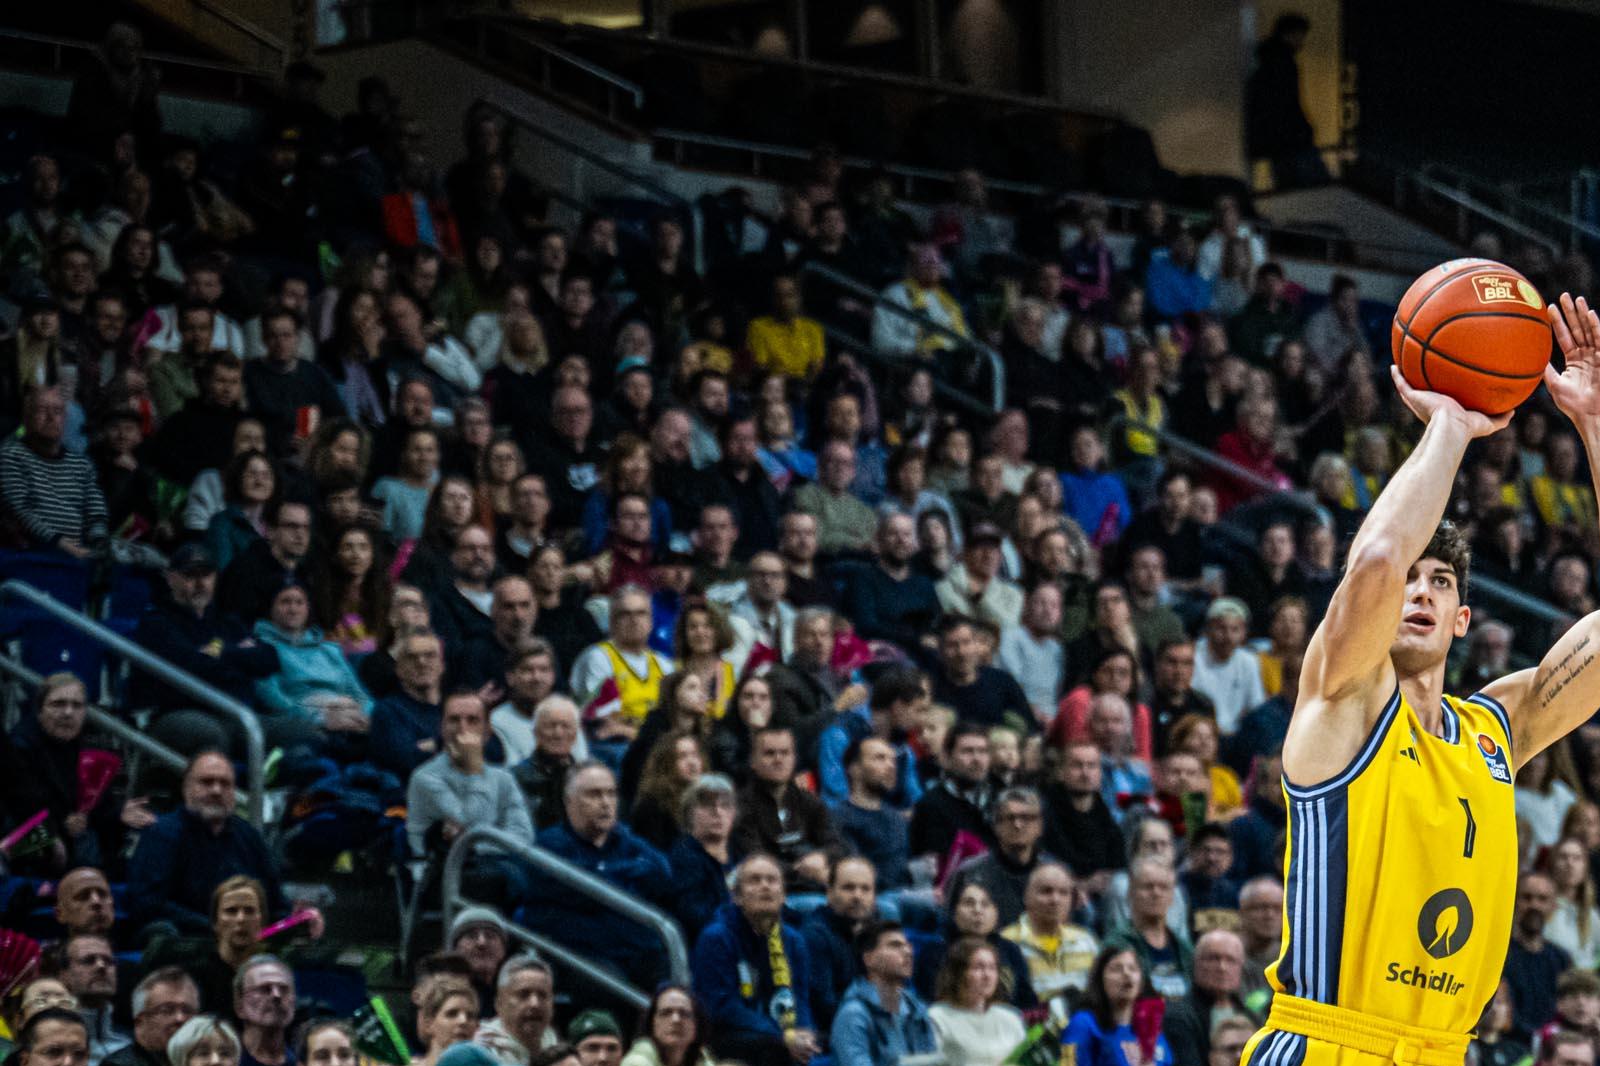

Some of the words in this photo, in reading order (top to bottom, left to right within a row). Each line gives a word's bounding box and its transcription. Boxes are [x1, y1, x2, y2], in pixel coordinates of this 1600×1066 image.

[1484, 287, 1516, 300] BBL
[1457, 796, 1477, 859] 1
[1386, 962, 1465, 996] Schidlr
